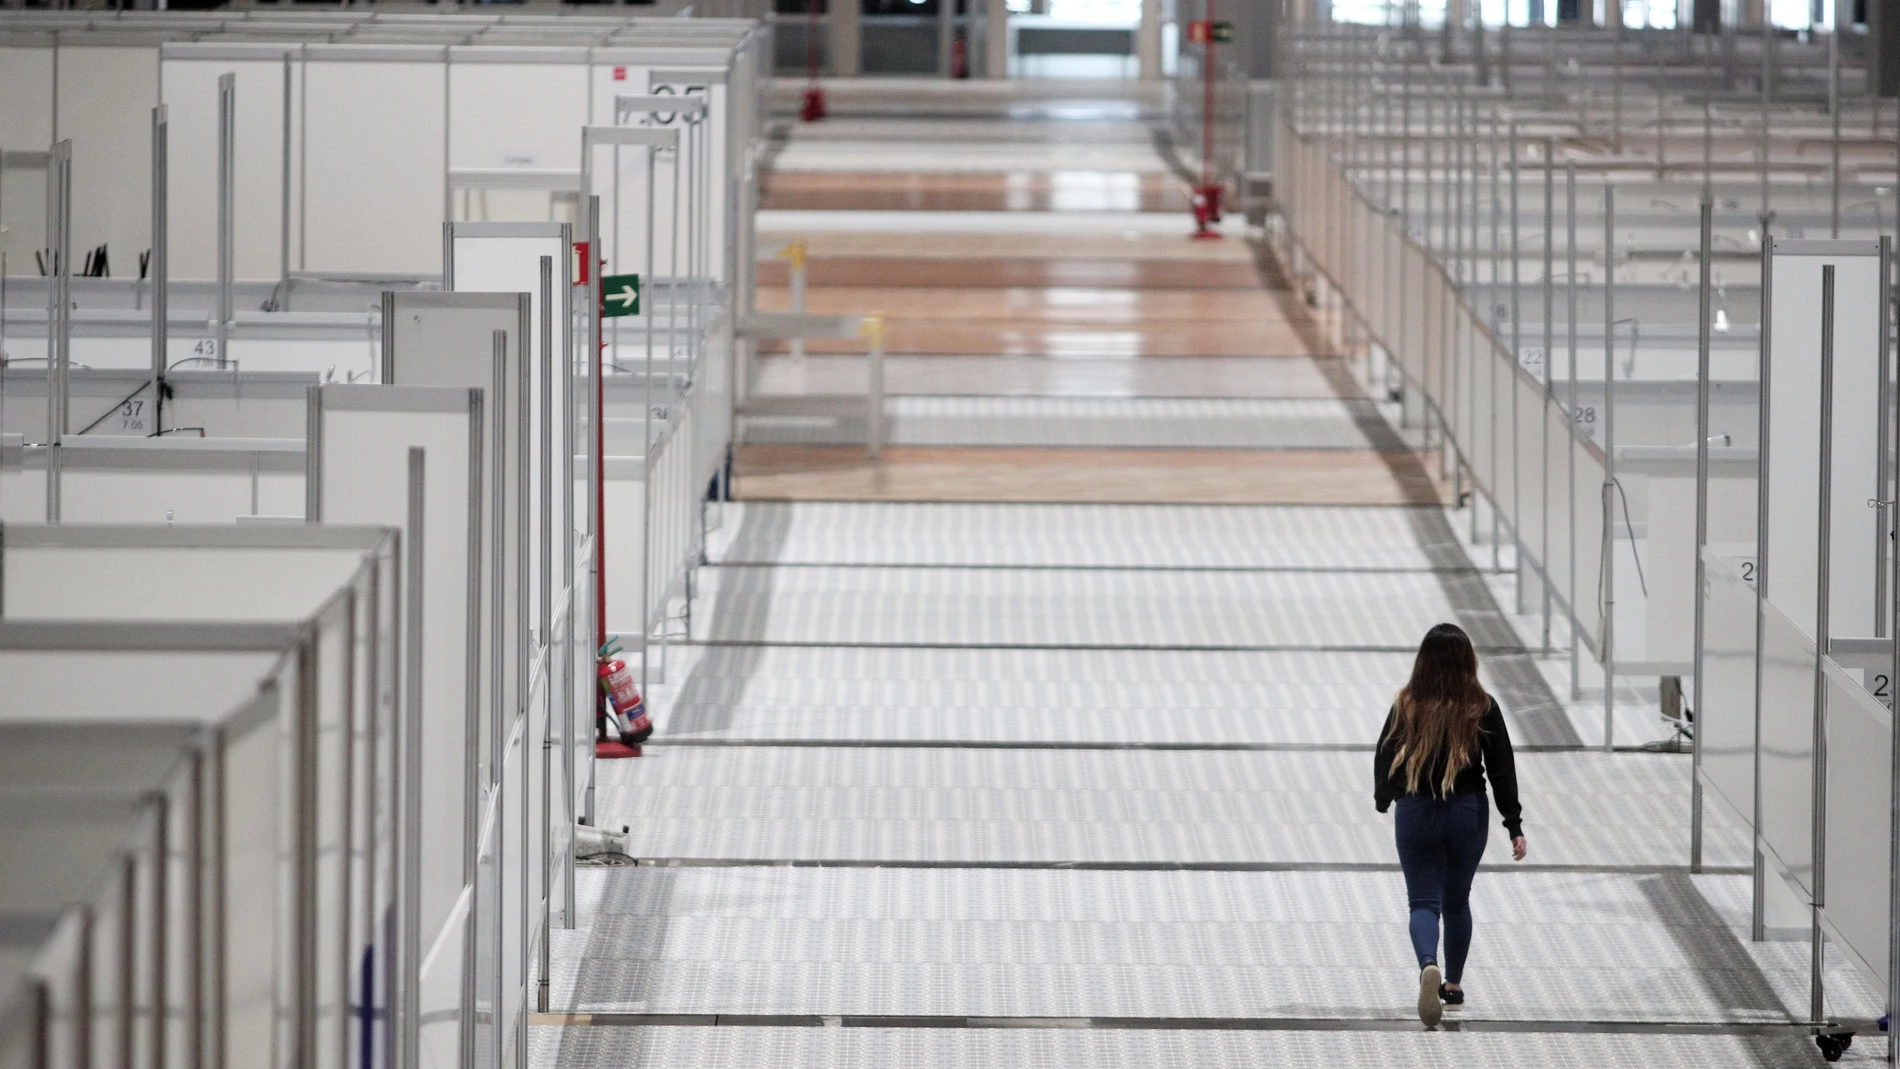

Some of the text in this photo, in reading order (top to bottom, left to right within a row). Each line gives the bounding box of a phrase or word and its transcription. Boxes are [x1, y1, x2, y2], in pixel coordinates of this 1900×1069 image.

[193, 339, 215, 355] 43
[1523, 349, 1541, 365] 22
[122, 400, 144, 416] 37
[1575, 406, 1596, 424] 28
[1741, 561, 1757, 581] 2
[1874, 674, 1893, 697] 2
